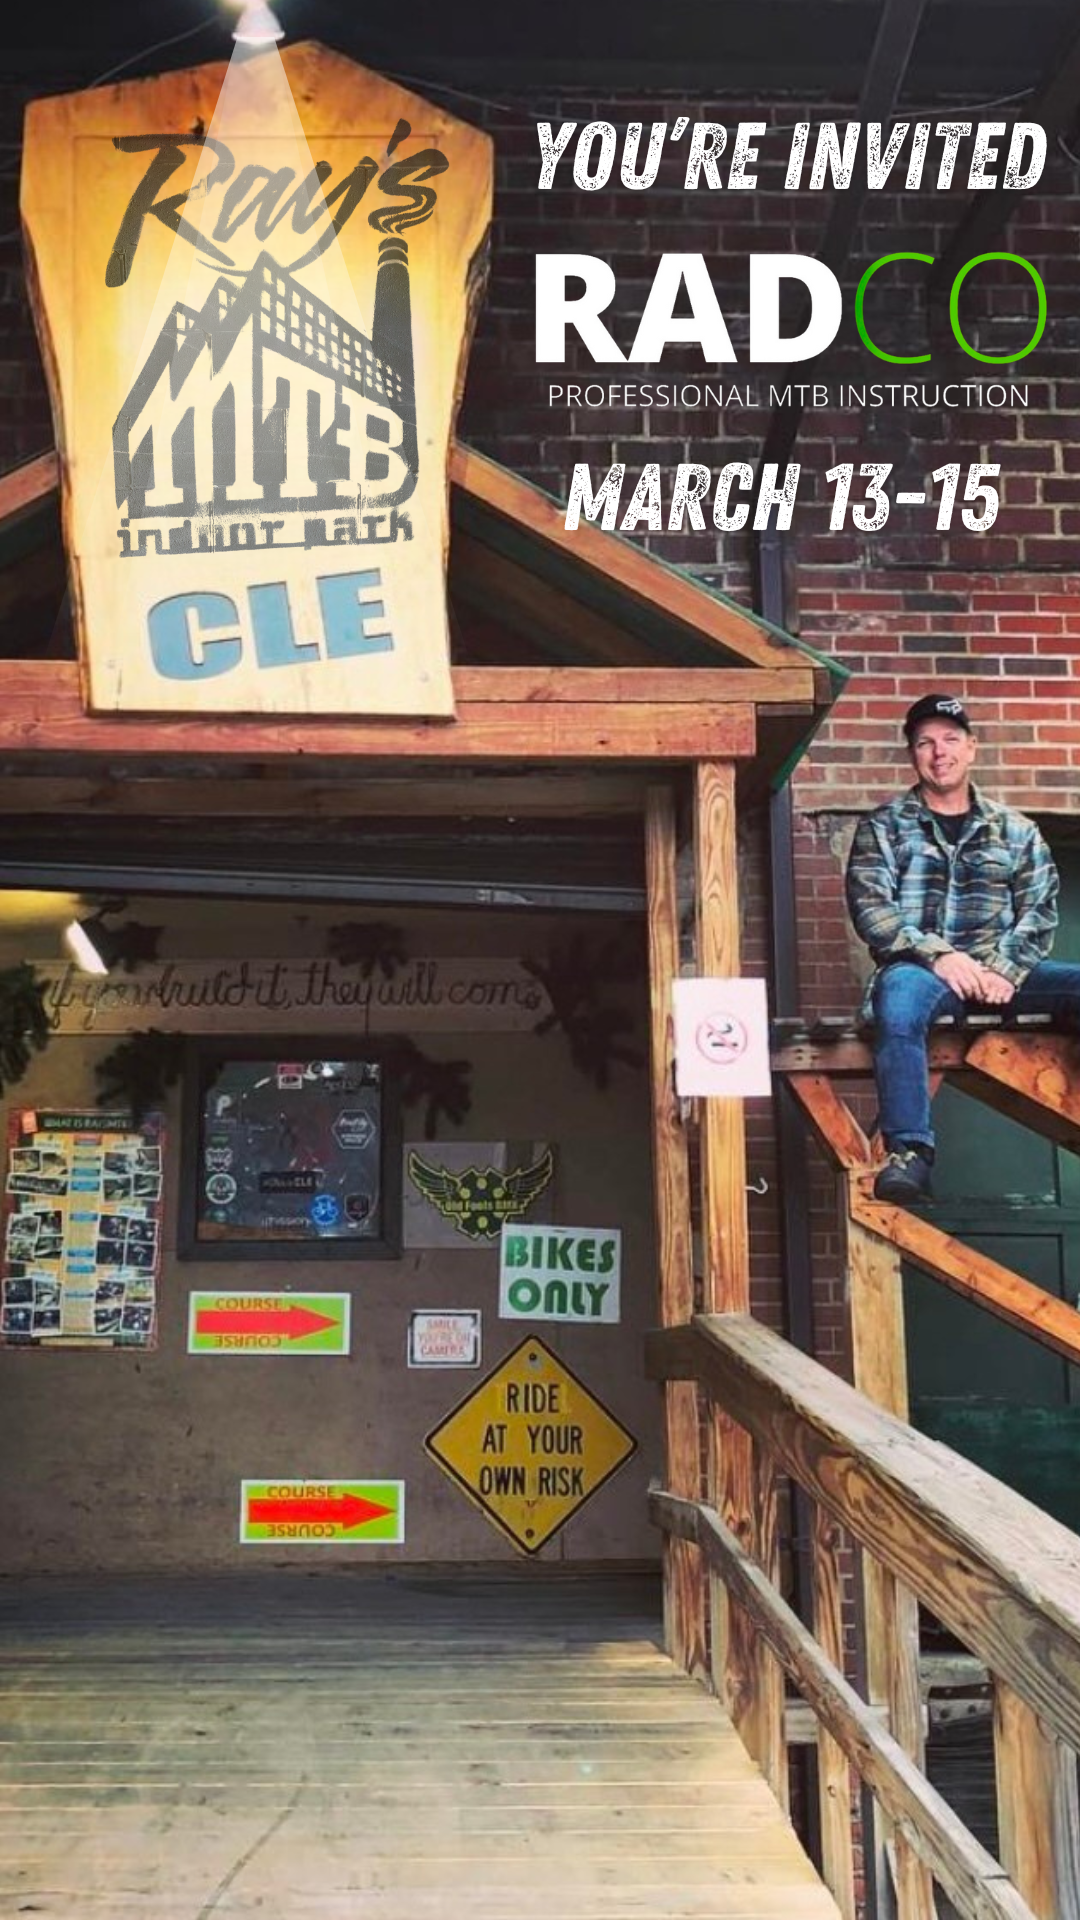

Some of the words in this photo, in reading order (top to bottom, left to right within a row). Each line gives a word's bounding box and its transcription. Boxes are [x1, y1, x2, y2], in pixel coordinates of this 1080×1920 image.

[105, 118, 449, 288] Ray's
[126, 312, 412, 506] MTB
[146, 567, 395, 682] CLE
[504, 1235, 617, 1274] BIKES
[214, 1297, 283, 1311] COURSE
[507, 1277, 610, 1317] ONLY
[214, 1335, 283, 1348] COURSE
[506, 1383, 560, 1414] RIDE
[482, 1423, 508, 1455] AT
[527, 1424, 584, 1456] YOUR
[266, 1485, 336, 1499] COURSE
[480, 1464, 526, 1496] OWN
[538, 1465, 585, 1497] RISK
[266, 1523, 336, 1538] COURSE
